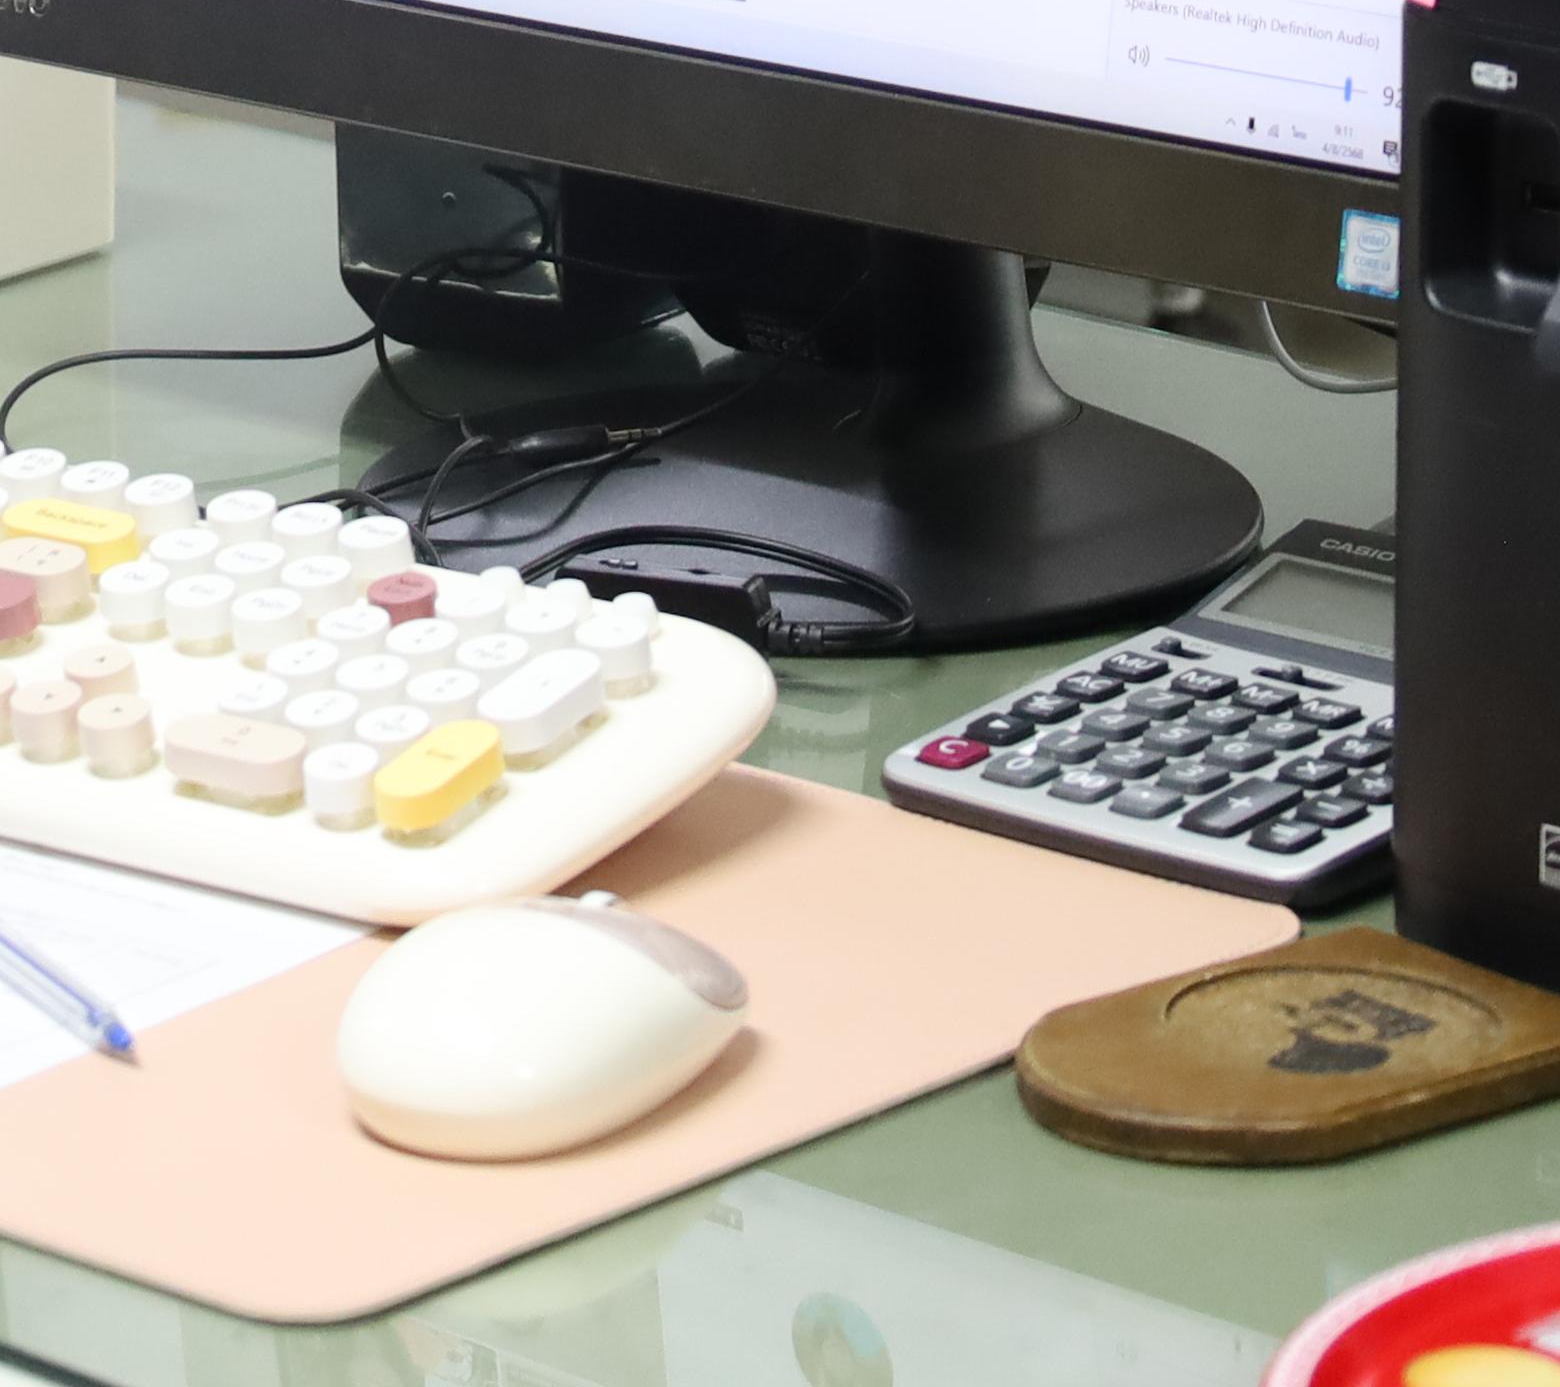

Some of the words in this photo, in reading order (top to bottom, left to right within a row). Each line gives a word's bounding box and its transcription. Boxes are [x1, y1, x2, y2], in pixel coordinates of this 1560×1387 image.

[1183, 3, 1232, 25] (Realtek
[1236, 13, 1267, 32] High
[1270, 18, 1333, 41] Definition
[1336, 29, 1381, 51] Audio)
[1319, 538, 1397, 562] CASIO
[1111, 652, 1160, 671] MU
[1066, 674, 1113, 691] AC
[1181, 670, 1224, 688] M+
[1146, 691, 1175, 704] 7
[1205, 707, 1236, 720] 8
[1301, 700, 1348, 717] MR
[1099, 712, 1128, 726] 4
[1159, 725, 1192, 740] 5
[1266, 721, 1296, 734] 9
[938, 738, 970, 756] C
[1057, 734, 1080, 747] 1
[1223, 741, 1255, 754] 6
[1005, 756, 1035, 772] 0
[1111, 749, 1145, 764] 2
[1175, 763, 1207, 778] 3
[1063, 770, 1108, 790] 00
